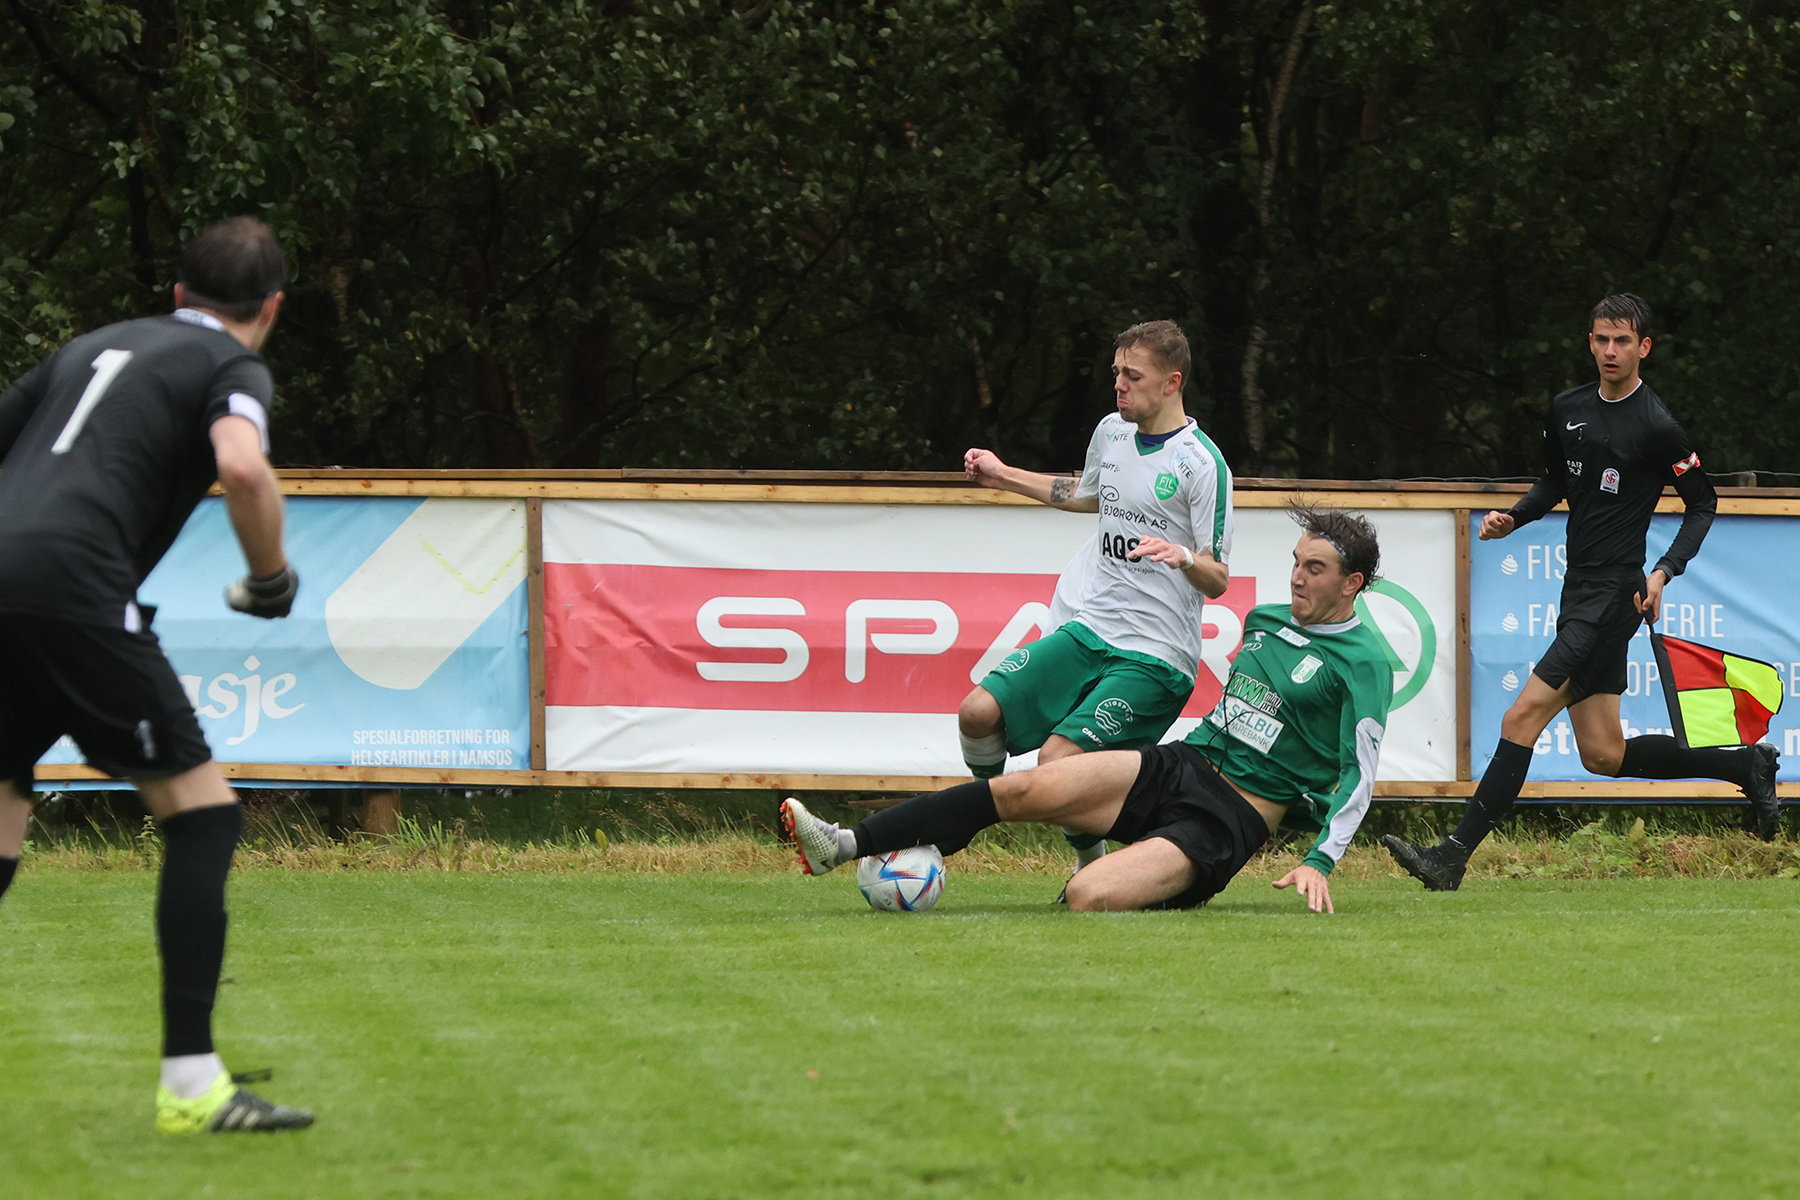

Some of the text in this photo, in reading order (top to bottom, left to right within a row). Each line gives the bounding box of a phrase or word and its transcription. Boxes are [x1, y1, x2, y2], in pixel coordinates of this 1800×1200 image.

[51, 349, 133, 454] 1
[1113, 433, 1129, 442] NTE
[1159, 476, 1174, 489] FIL
[1104, 505, 1168, 530] BJØRØYA AS
[1103, 532, 1142, 563] AQS
[1528, 544, 1567, 579] FIS
[1229, 704, 1278, 738] SELBU
[353, 729, 510, 744] SPESIALFORRETNING FOR
[351, 749, 513, 765] HELSEARTIKLER I NAMSOS
